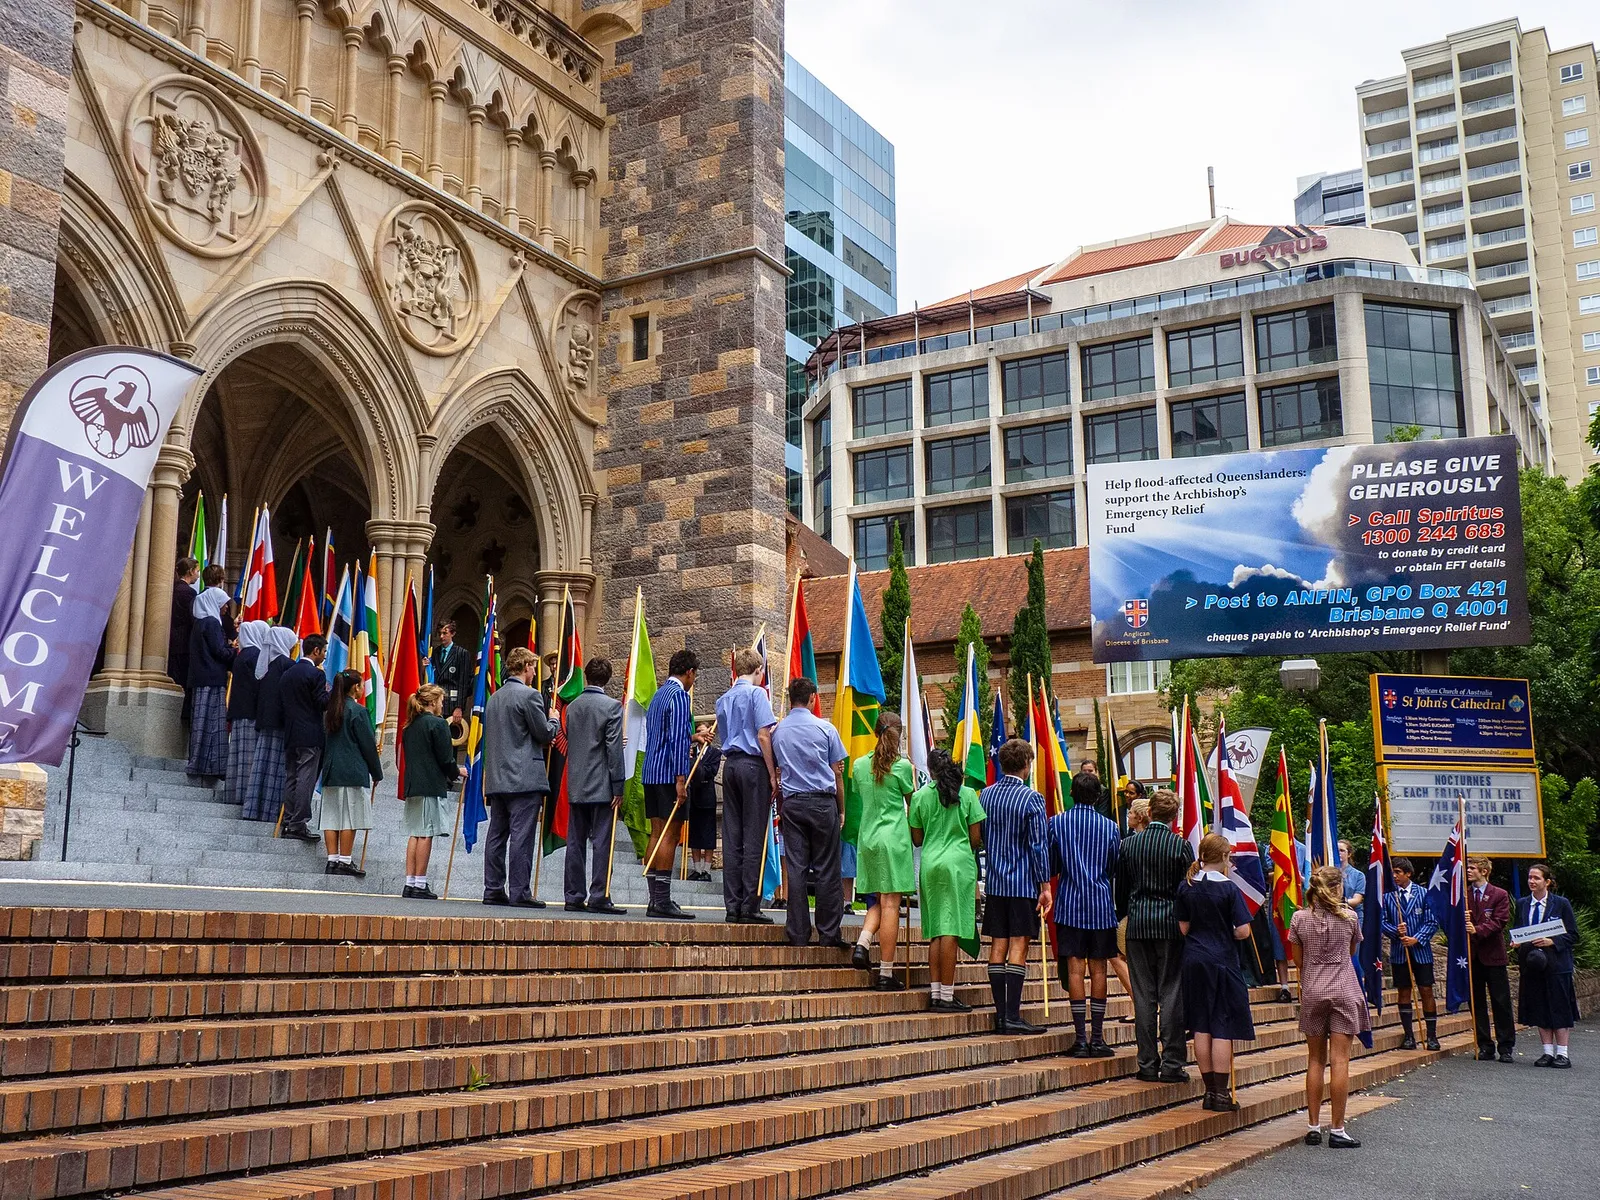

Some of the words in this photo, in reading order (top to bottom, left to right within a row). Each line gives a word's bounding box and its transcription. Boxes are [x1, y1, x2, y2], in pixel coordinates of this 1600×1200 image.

[1220, 235, 1328, 269] BUCYRUS
[1352, 459, 1438, 479] PLEASE
[1445, 454, 1500, 472] GIVE
[1105, 480, 1132, 492] Help
[1134, 473, 1213, 488] flood-affected
[1216, 468, 1306, 484] Queenslanders:
[1349, 476, 1503, 500] GENEROUSLY
[1105, 491, 1149, 506] support
[1152, 491, 1170, 502] the
[1173, 486, 1247, 502] Archbishop's
[1105, 505, 1168, 520] Emergency
[1171, 504, 1205, 515] Relief
[1368, 510, 1410, 526] Call
[1417, 505, 1504, 526] Spiritus
[1106, 523, 1135, 534] Fund
[1361, 528, 1410, 545] 1300
[1417, 525, 1457, 542] 244
[1465, 523, 1505, 540] 683
[1378, 550, 1389, 559] to
[1392, 548, 1428, 558] donate
[1431, 547, 1444, 558] by
[1447, 545, 1478, 555] credit
[1481, 544, 1505, 553] card
[1395, 564, 1406, 573] or
[1409, 562, 1442, 572] obtain
[1446, 560, 1467, 570] EFT
[1470, 559, 1506, 569] details
[1204, 593, 1250, 610] Post
[1257, 592, 1278, 607] to
[1284, 588, 1359, 606] ANFIN,
[1366, 585, 1412, 602] GPO
[1419, 583, 1462, 599] Box
[1467, 580, 1508, 597] 421
[1329, 606, 1425, 623] Brisbane
[1432, 602, 1449, 618] Q
[1455, 599, 1508, 616] 4001
[1207, 632, 1249, 643] cheques
[1251, 630, 1291, 642] payable
[1294, 630, 1304, 638] to
[1383, 624, 1442, 636] Emergency
[1445, 622, 1477, 632] Relief
[1414, 687, 1438, 695] Anglican
[1402, 696, 1413, 707] St
[1415, 696, 1448, 710] John's
[1451, 698, 1506, 710] Cathedral
[1435, 775, 1491, 786] NOCTURNES
[1404, 787, 1429, 798] EACH
[1435, 788, 1472, 799] FRIDAY
[1480, 789, 1491, 799] IN
[1498, 789, 1521, 800] LENT
[1430, 801, 1448, 811] 7TH
[1502, 802, 1520, 813] APR
[1430, 814, 1454, 824] FREE
[1460, 815, 1504, 825] ONCERT
[1524, 924, 1563, 937] Commonwealth
